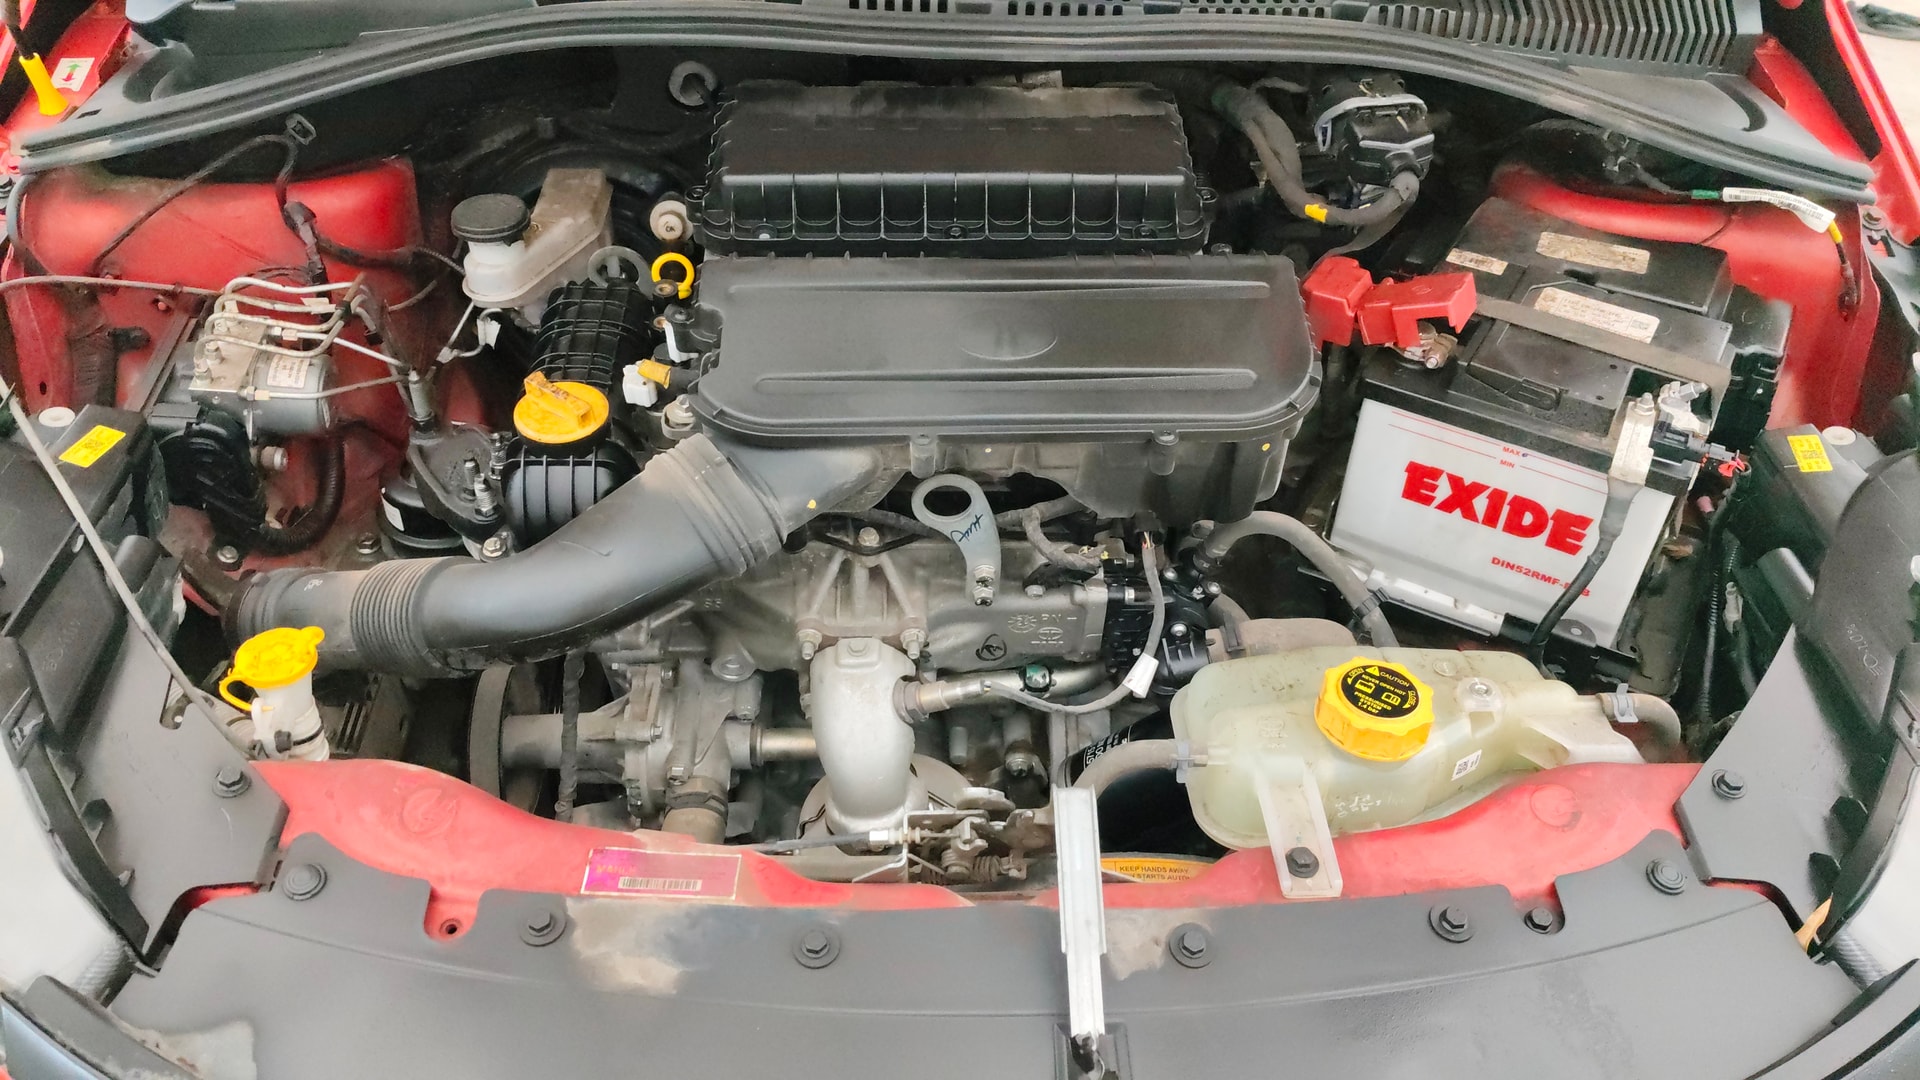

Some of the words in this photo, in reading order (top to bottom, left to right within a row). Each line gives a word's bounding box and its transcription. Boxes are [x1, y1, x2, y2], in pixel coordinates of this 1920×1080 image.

[1502, 446, 1520, 456] MAX
[1500, 459, 1515, 468] MIN
[1401, 460, 1594, 556] EXIDE
[1361, 674, 1380, 685] NEVER
[1380, 682, 1395, 691] OPEN
[1394, 688, 1407, 696] HOT
[1380, 671, 1410, 688] CAUTION
[1360, 698, 1382, 711] SYSTEM
